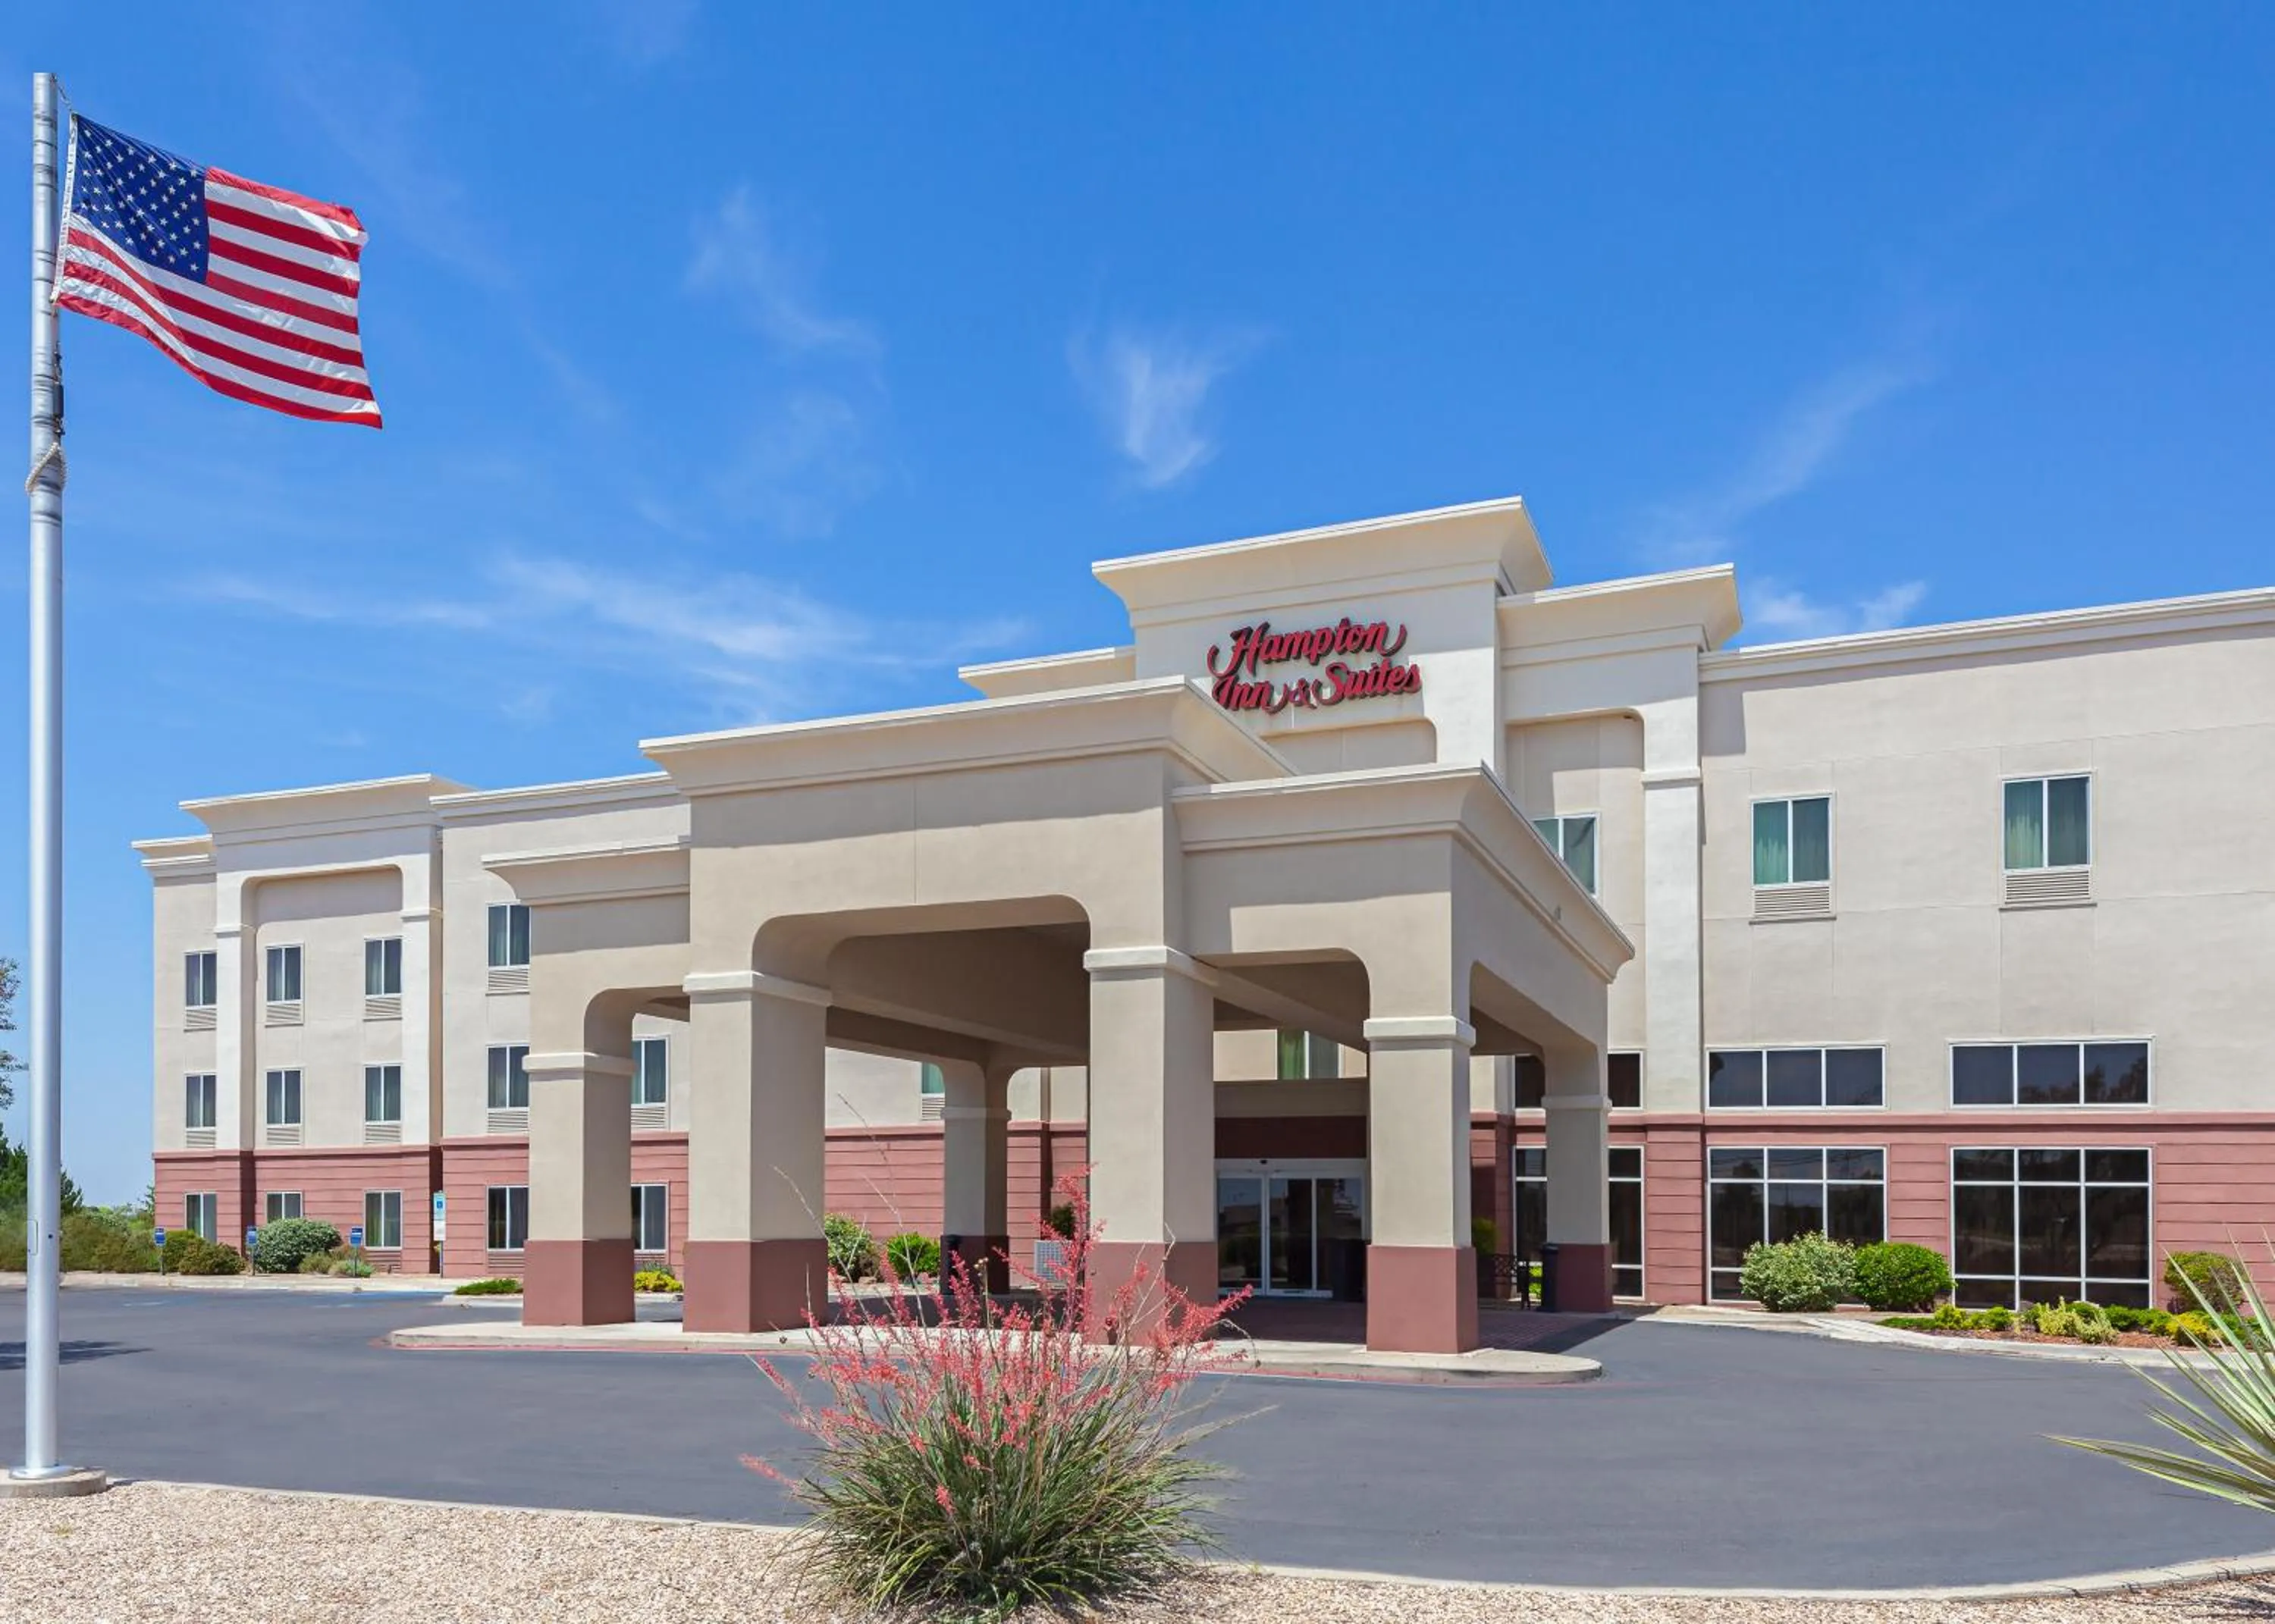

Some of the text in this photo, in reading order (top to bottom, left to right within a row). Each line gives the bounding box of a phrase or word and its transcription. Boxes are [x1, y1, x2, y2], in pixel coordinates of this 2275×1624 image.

[1207, 617, 1407, 676] Hampton
[1212, 658, 1422, 713] Inn & Suites
